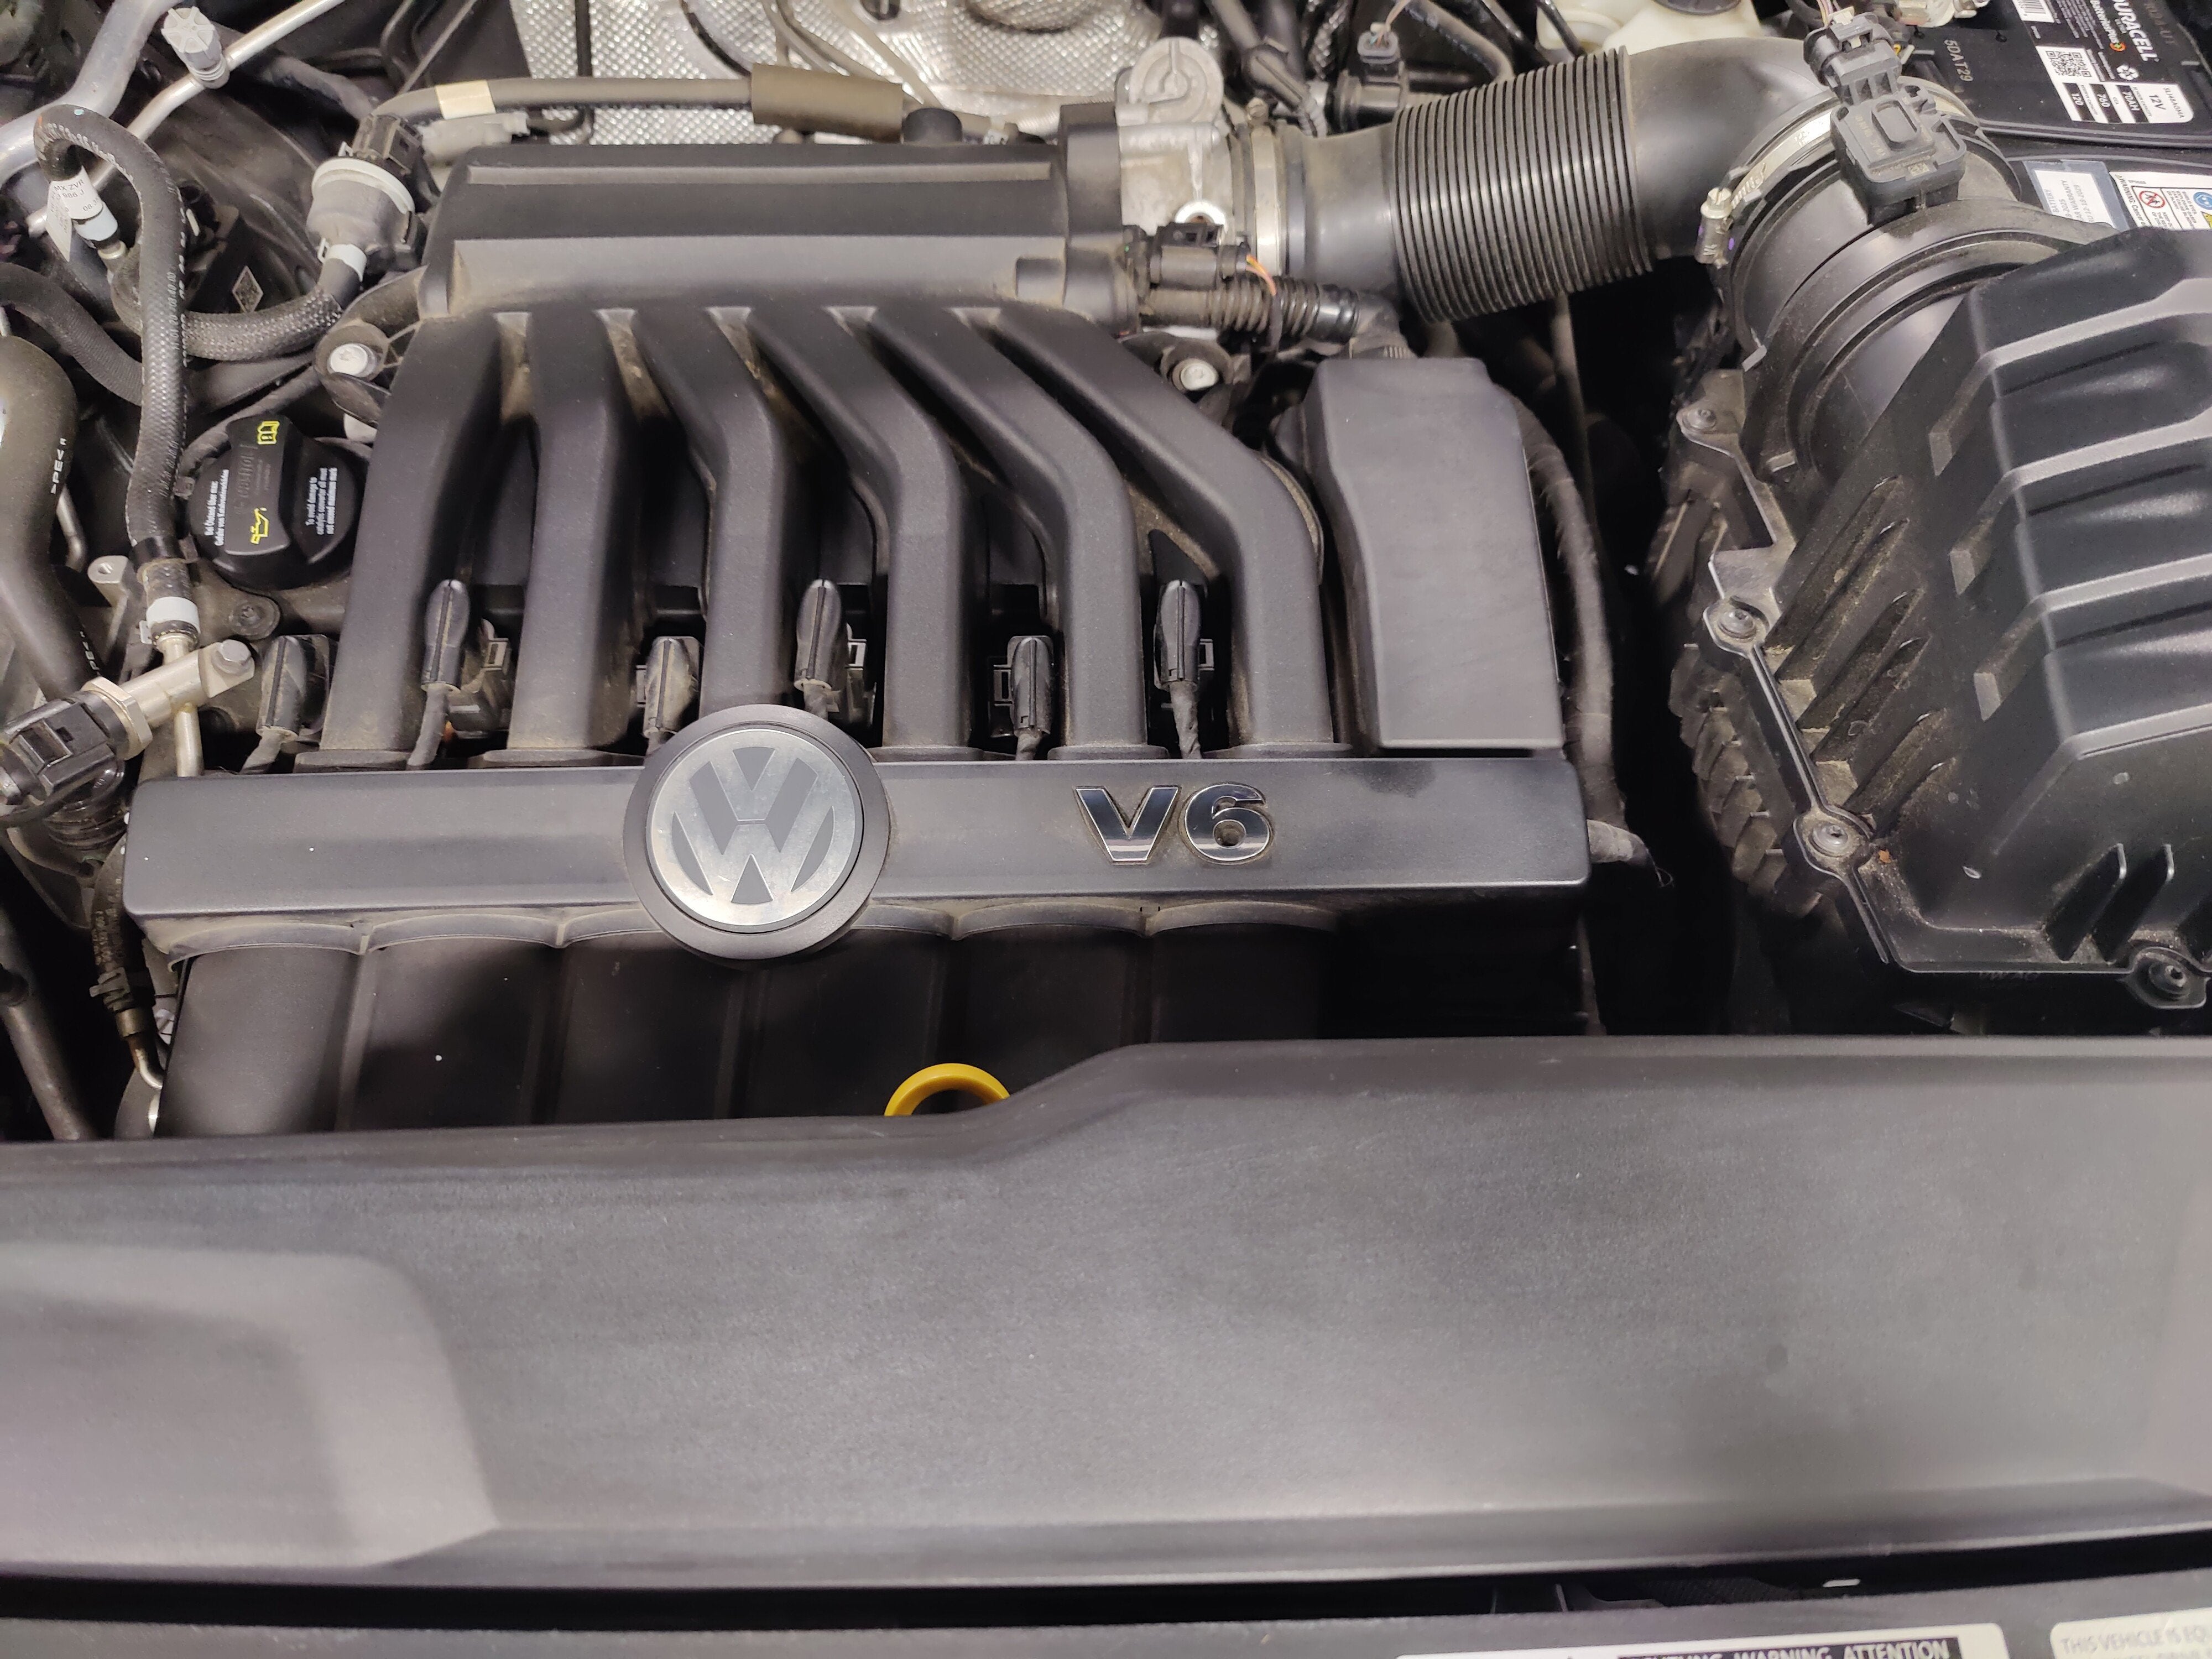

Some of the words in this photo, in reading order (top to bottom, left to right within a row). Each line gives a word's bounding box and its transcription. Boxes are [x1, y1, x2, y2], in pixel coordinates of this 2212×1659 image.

[2112, 0, 2158, 61] URACELL
[1944, 39, 1974, 82] 5DAT29
[2071, 93, 2085, 106] 120
[2096, 93, 2111, 107] 760
[2122, 91, 2141, 111] 70AH
[2149, 94, 2166, 111] 12V
[2060, 180, 2079, 211] WARRANTY
[2120, 178, 2136, 204] WARNING:
[1074, 782, 1273, 864] V6
[1843, 1640, 1950, 1659] ATTENTION
